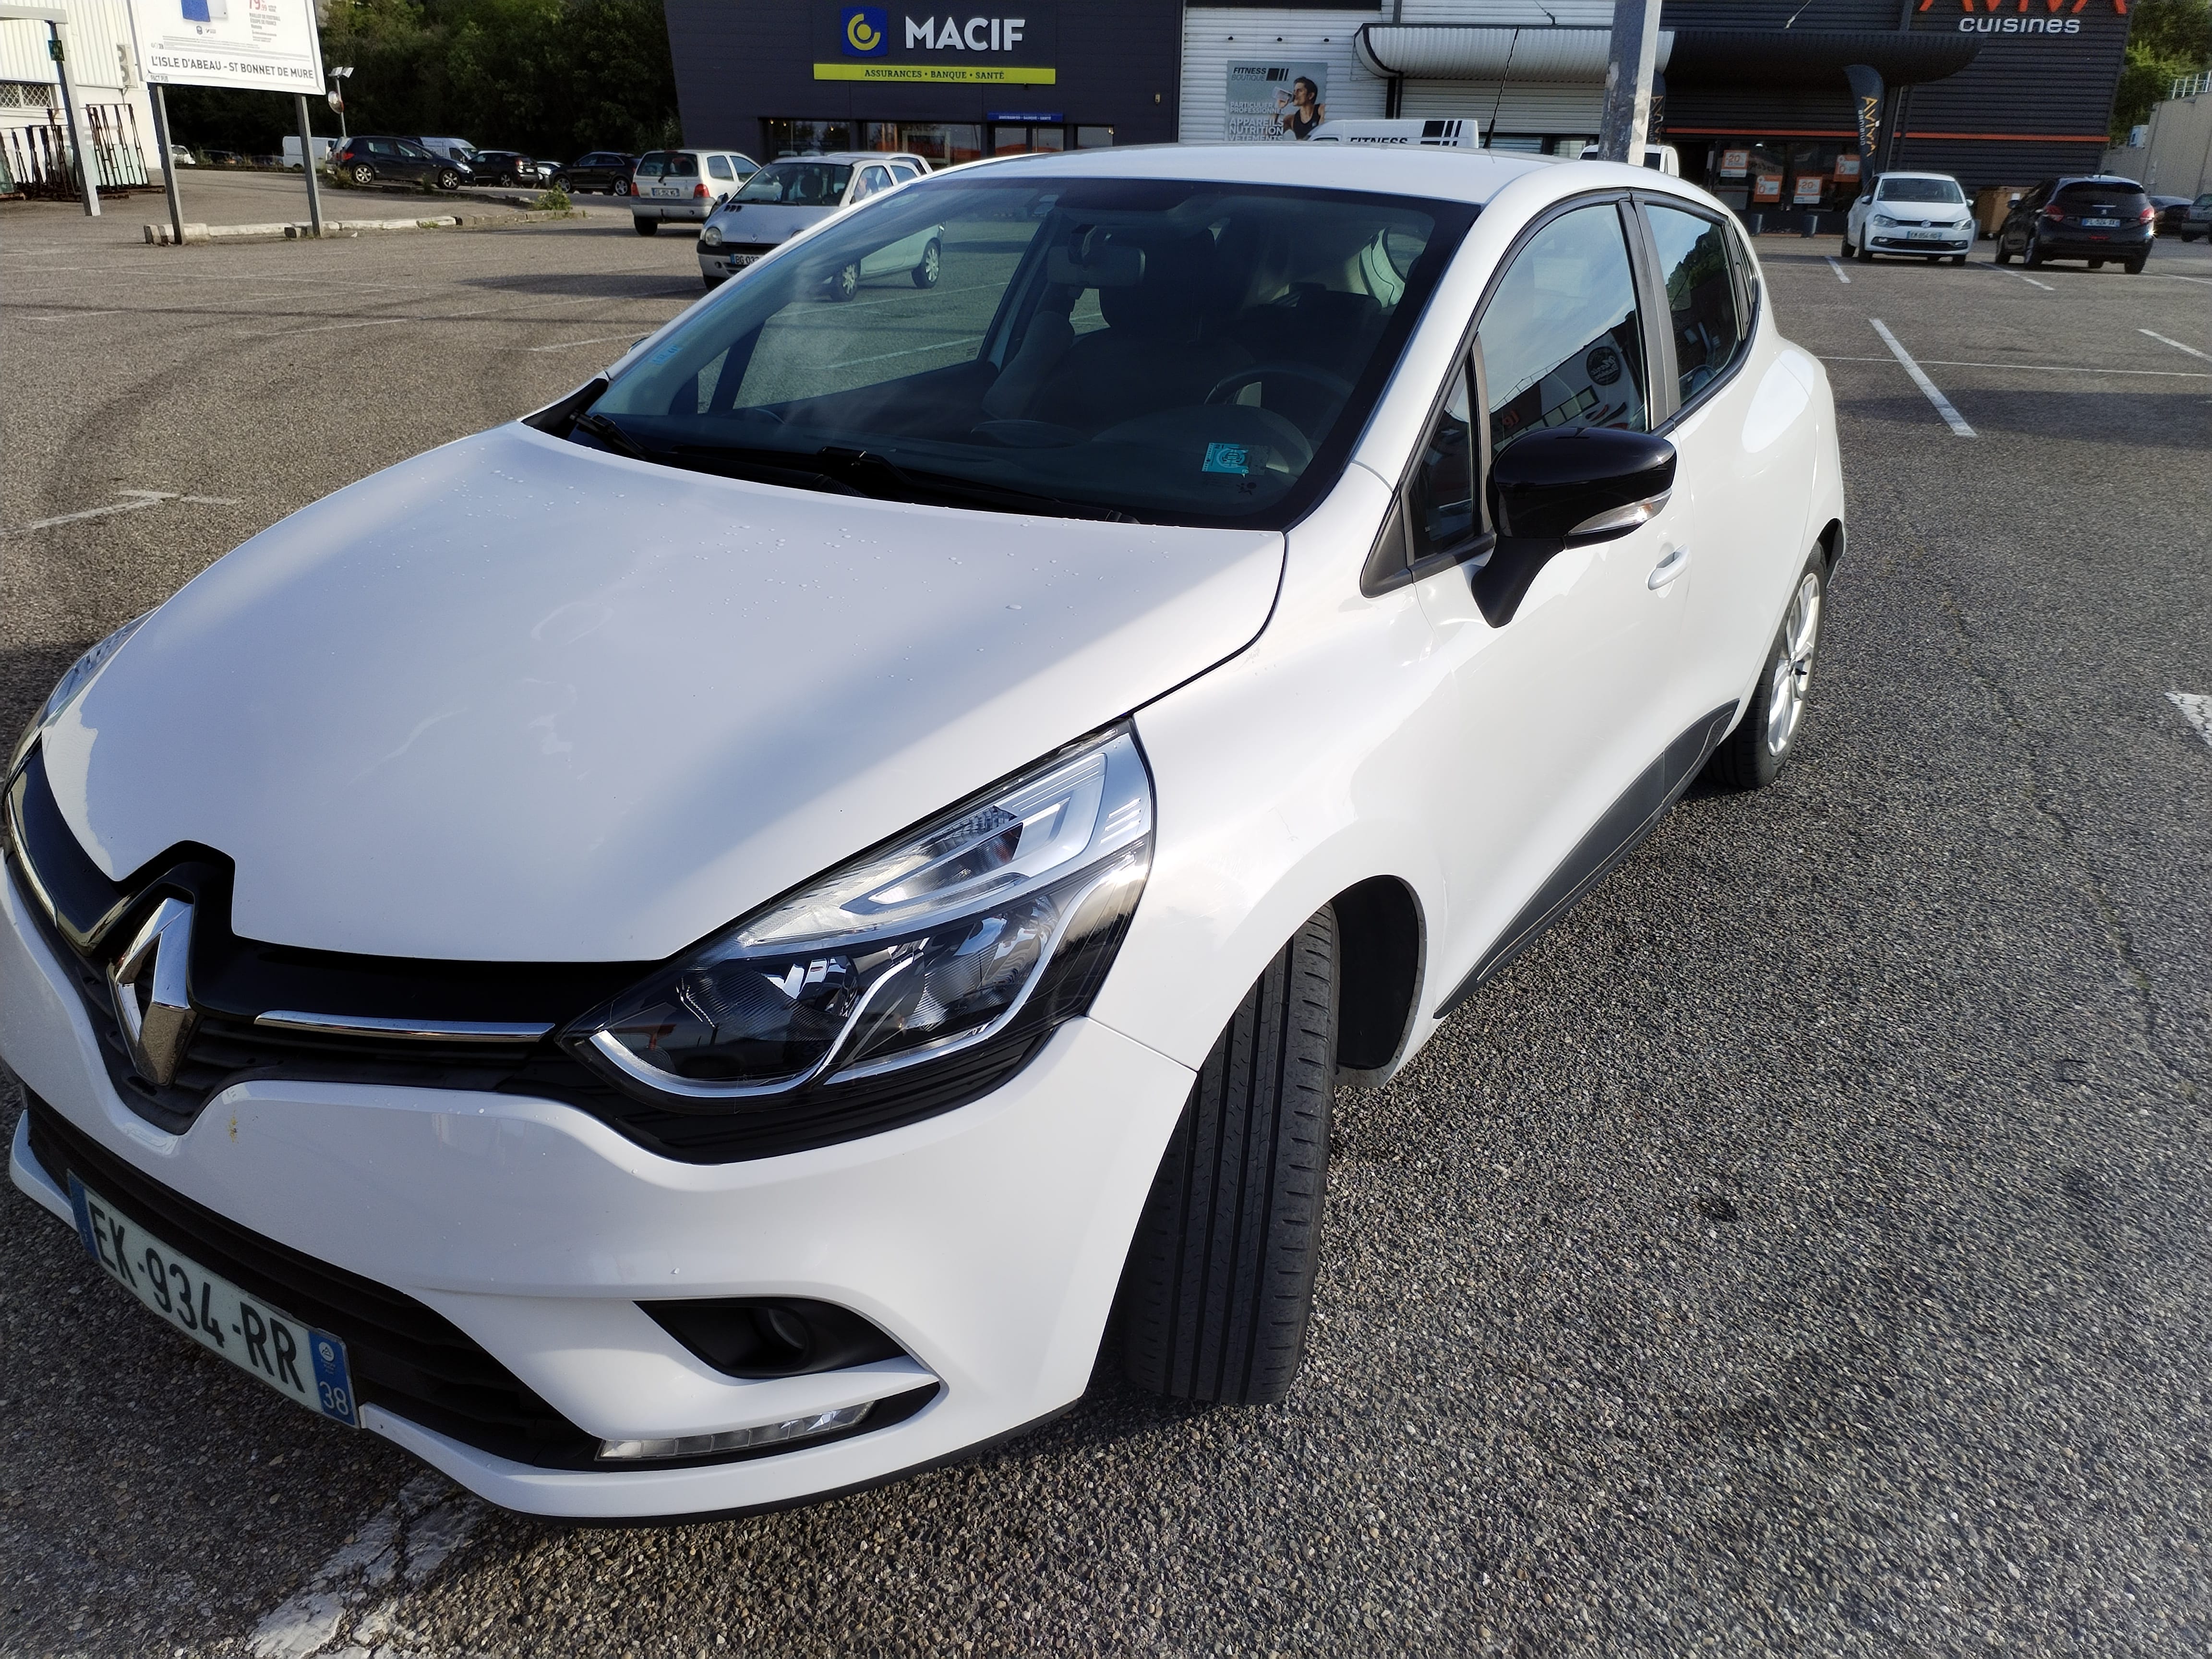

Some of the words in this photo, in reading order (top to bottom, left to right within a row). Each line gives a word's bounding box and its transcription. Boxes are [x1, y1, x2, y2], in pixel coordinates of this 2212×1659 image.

[905, 15, 1026, 51] MACIF
[151, 56, 180, 68] L'ISLE
[182, 58, 221, 71] D'ABEAU
[240, 63, 275, 75] BONNET
[277, 67, 289, 77] DE
[290, 68, 314, 79] MURE
[865, 69, 922, 78] ASSURANCES
[930, 71, 967, 80] BANQUE
[975, 70, 1005, 80] SANTÉ
[1229, 118, 1284, 127] APPAREILS
[1229, 126, 1283, 135] NUTRITION
[88, 1200, 305, 1394] EK-934-RR
[319, 1381, 349, 1416] 38
